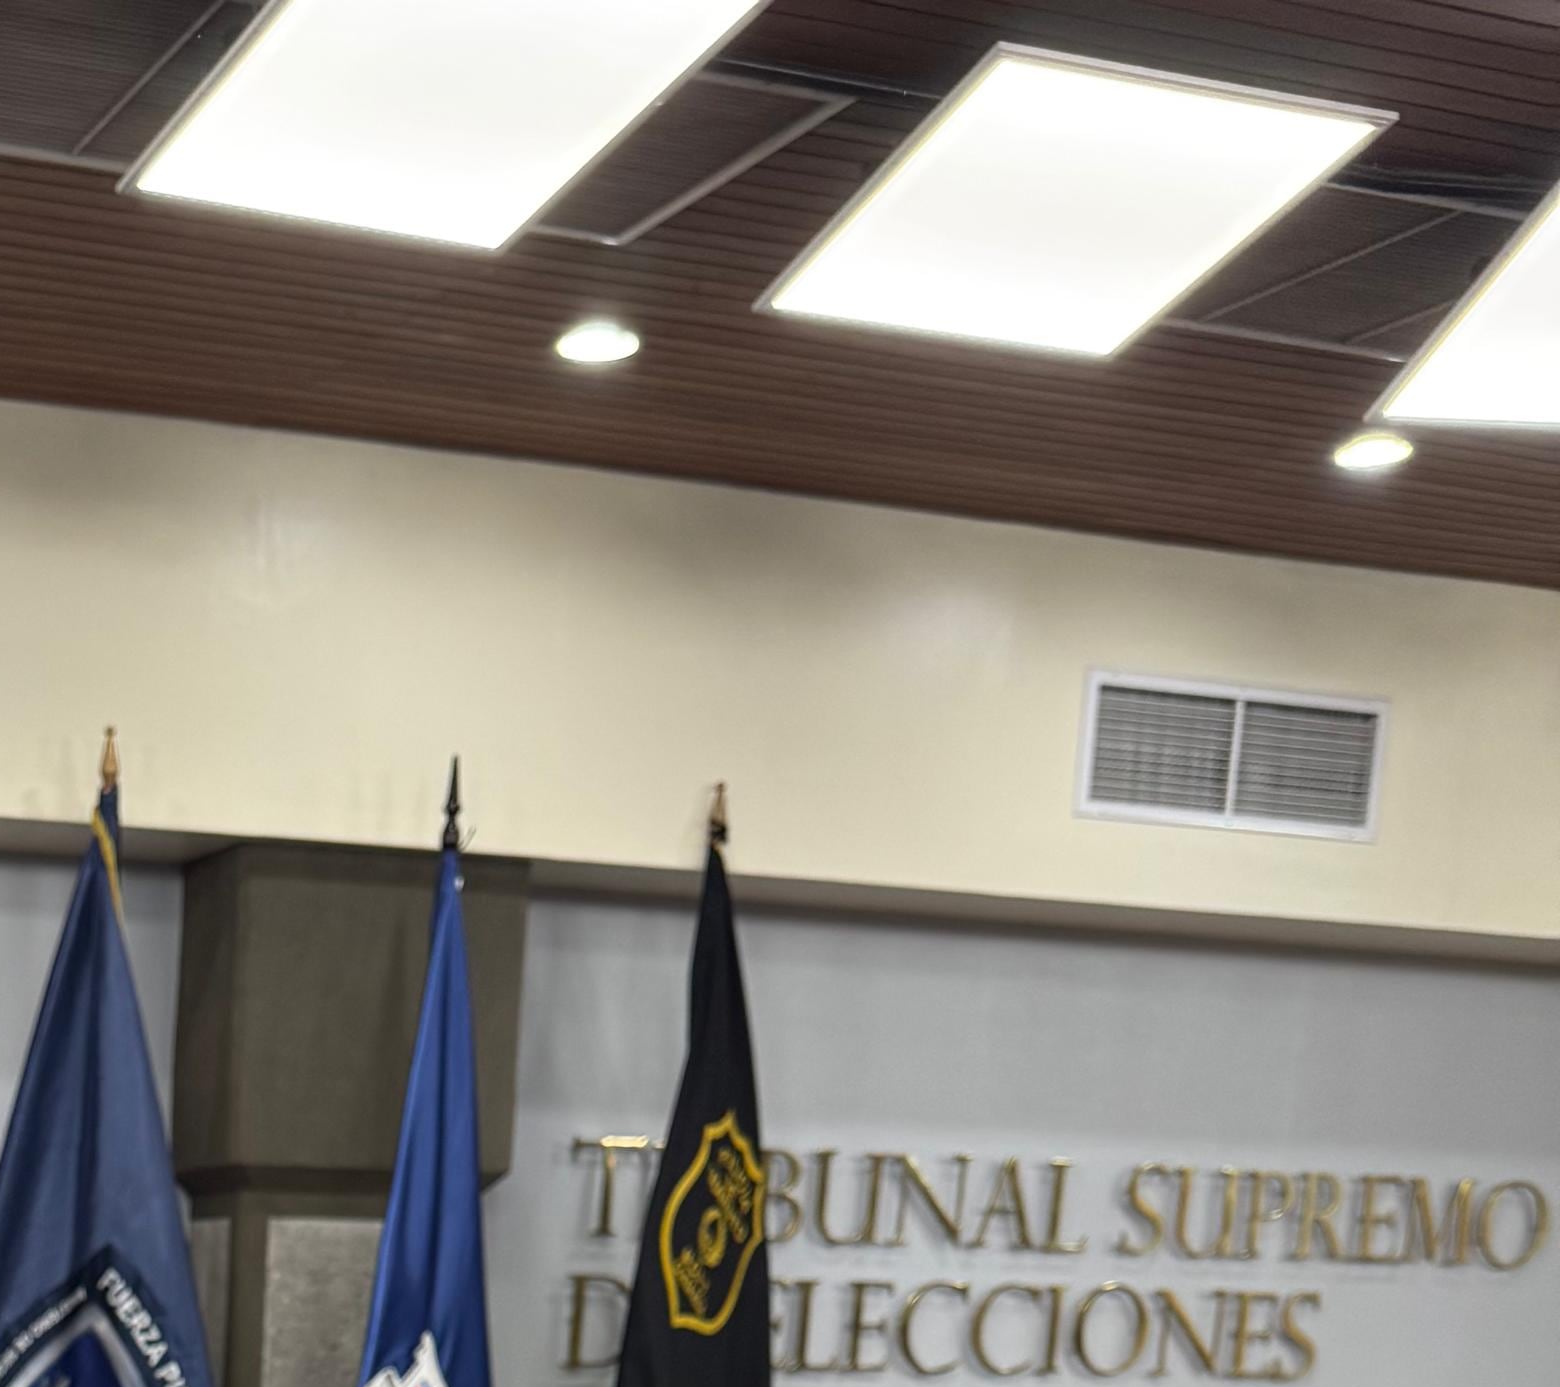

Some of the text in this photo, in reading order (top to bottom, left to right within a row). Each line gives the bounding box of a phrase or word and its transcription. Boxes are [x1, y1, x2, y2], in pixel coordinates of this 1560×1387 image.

[571, 1134, 1090, 1255] TBUNAL
[1116, 1158, 1549, 1270] SUPREMO
[97, 1267, 169, 1368] FUERZA
